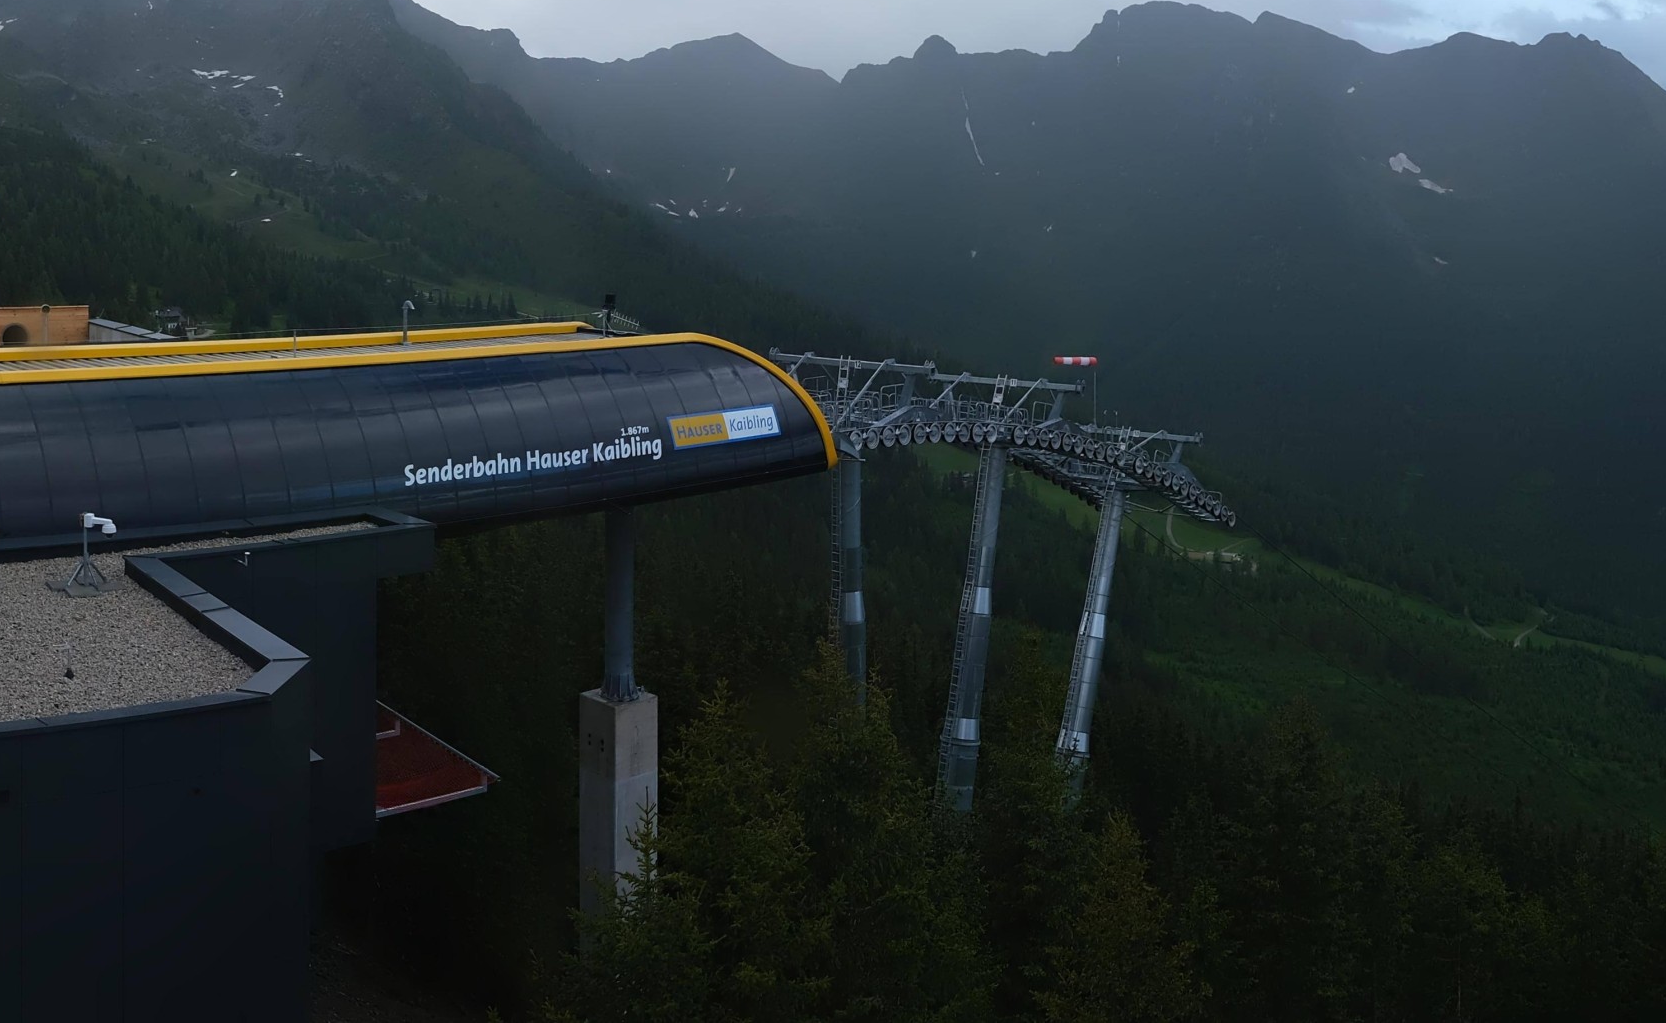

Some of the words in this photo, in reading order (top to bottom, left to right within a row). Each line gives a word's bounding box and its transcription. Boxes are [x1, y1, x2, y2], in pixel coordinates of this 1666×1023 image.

[620, 426, 650, 437] 1.867m
[676, 422, 723, 440] HAUSER
[729, 413, 774, 432] Kaibling
[404, 452, 521, 486] Senderbahn
[526, 446, 589, 471] Hauser
[592, 436, 662, 464] Kaibling
